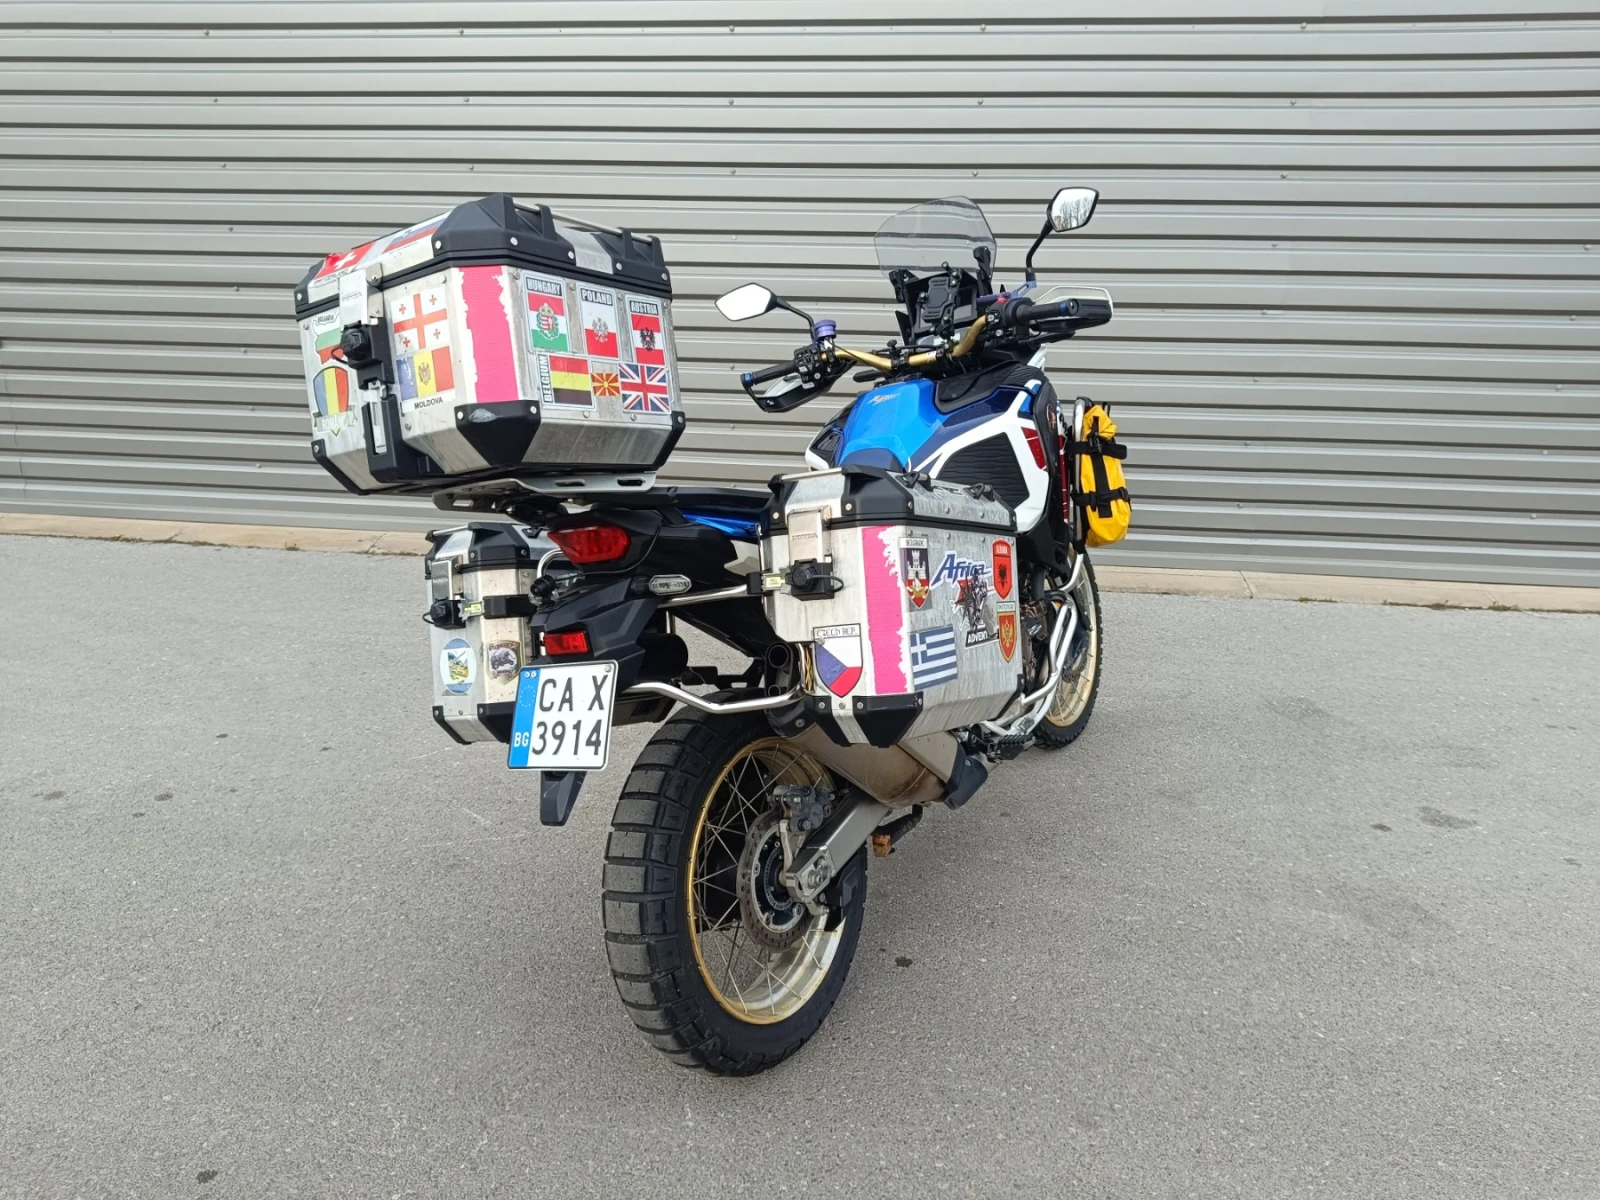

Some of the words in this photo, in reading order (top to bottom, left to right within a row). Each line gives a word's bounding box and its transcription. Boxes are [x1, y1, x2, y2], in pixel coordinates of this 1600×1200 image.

[526, 277, 562, 296] HUNGARY
[581, 289, 613, 305] POLAND
[630, 301, 659, 315] AUSTRIA
[538, 355, 554, 403] BELGIUM
[414, 396, 444, 410] MOLDOVA
[538, 677, 574, 713] CA
[588, 674, 609, 711] X
[513, 731, 530, 748] BG
[531, 719, 603, 757] 3914
